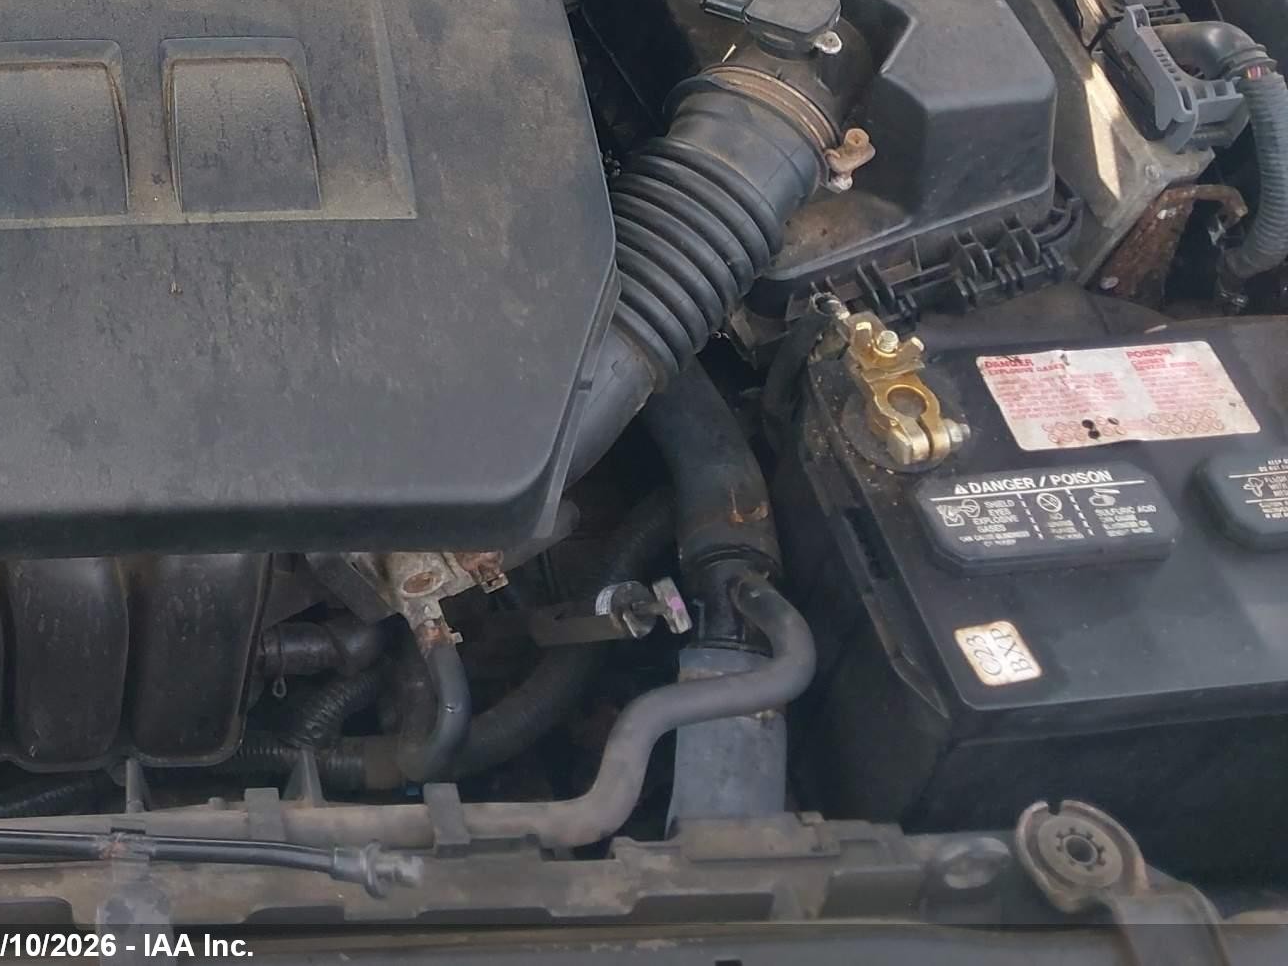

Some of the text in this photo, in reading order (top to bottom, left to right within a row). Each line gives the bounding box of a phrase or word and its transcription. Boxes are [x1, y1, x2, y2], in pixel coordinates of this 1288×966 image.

[968, 470, 1113, 494] DANGER / POISON
[966, 635, 1003, 676] C23
[991, 628, 1032, 672] BXP
